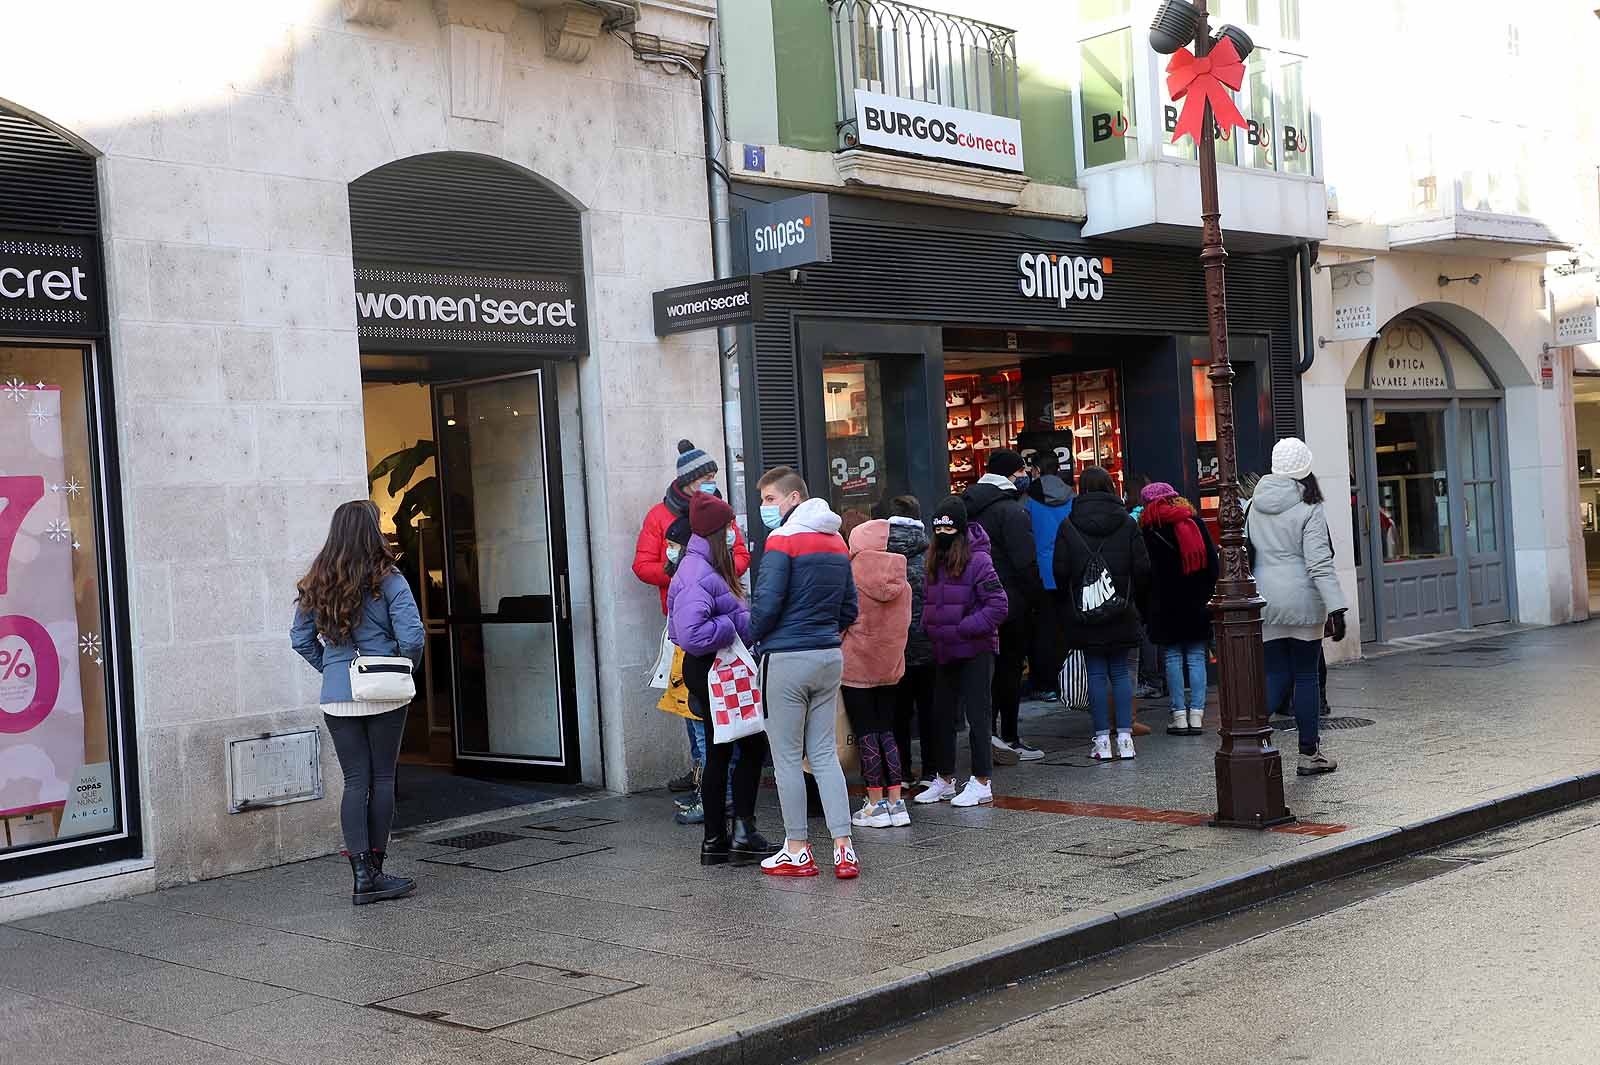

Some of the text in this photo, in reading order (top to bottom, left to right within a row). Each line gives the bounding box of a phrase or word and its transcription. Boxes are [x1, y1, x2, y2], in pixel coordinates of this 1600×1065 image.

[752, 150, 758, 167] 5
[755, 218, 805, 254] snipes
[1020, 252, 1104, 309] snipes
[356, 291, 577, 328] women'secret
[666, 291, 750, 318] women'secret
[832, 457, 848, 486] 3
[1082, 568, 1116, 612] NIKE
[76, 782, 102, 792] COPAS
